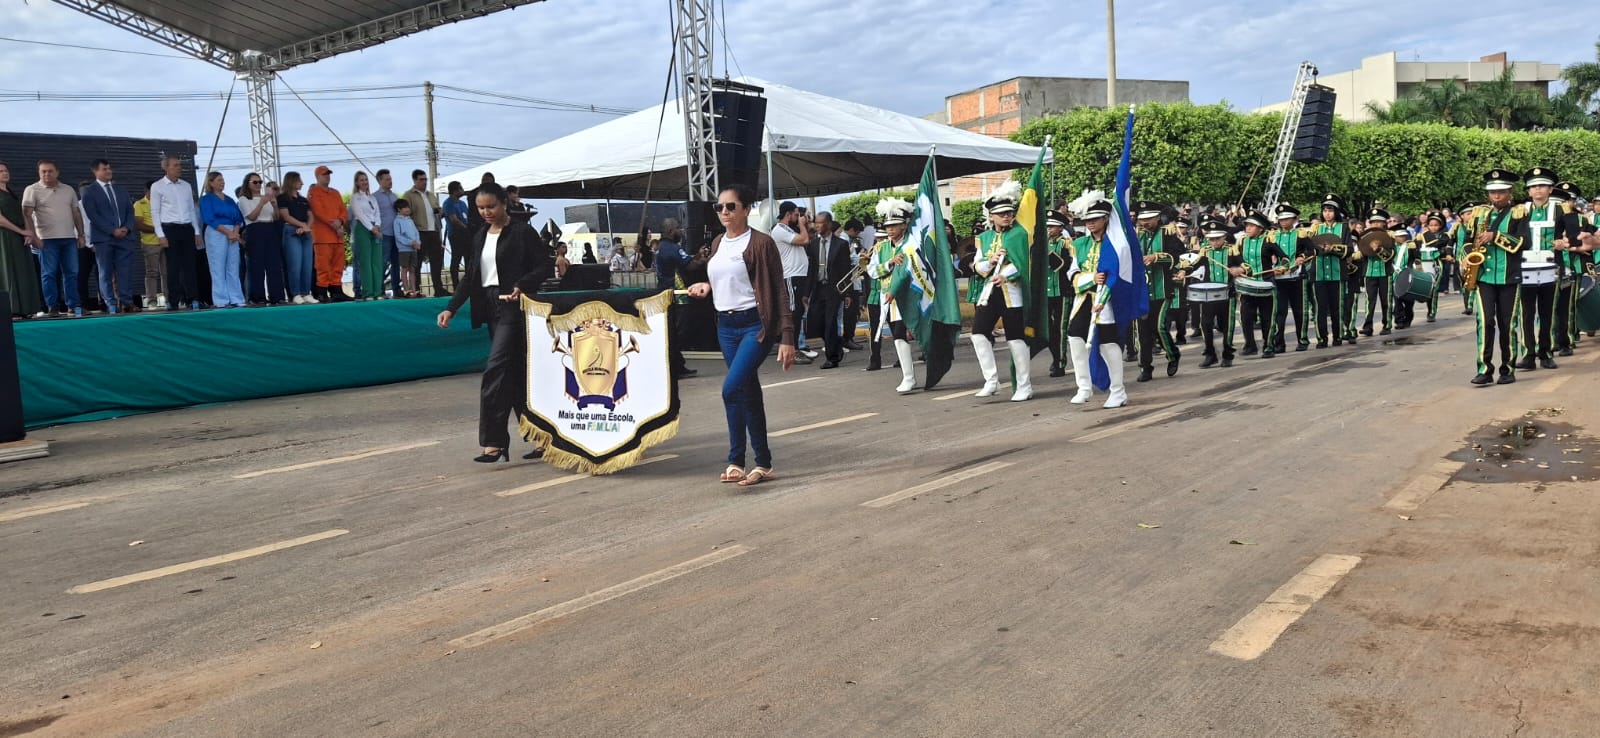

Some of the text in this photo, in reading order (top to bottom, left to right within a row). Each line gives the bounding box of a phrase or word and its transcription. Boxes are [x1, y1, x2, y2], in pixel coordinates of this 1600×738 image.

[558, 410, 635, 423] Mais que uma Escola,
[571, 423, 585, 431] uma
